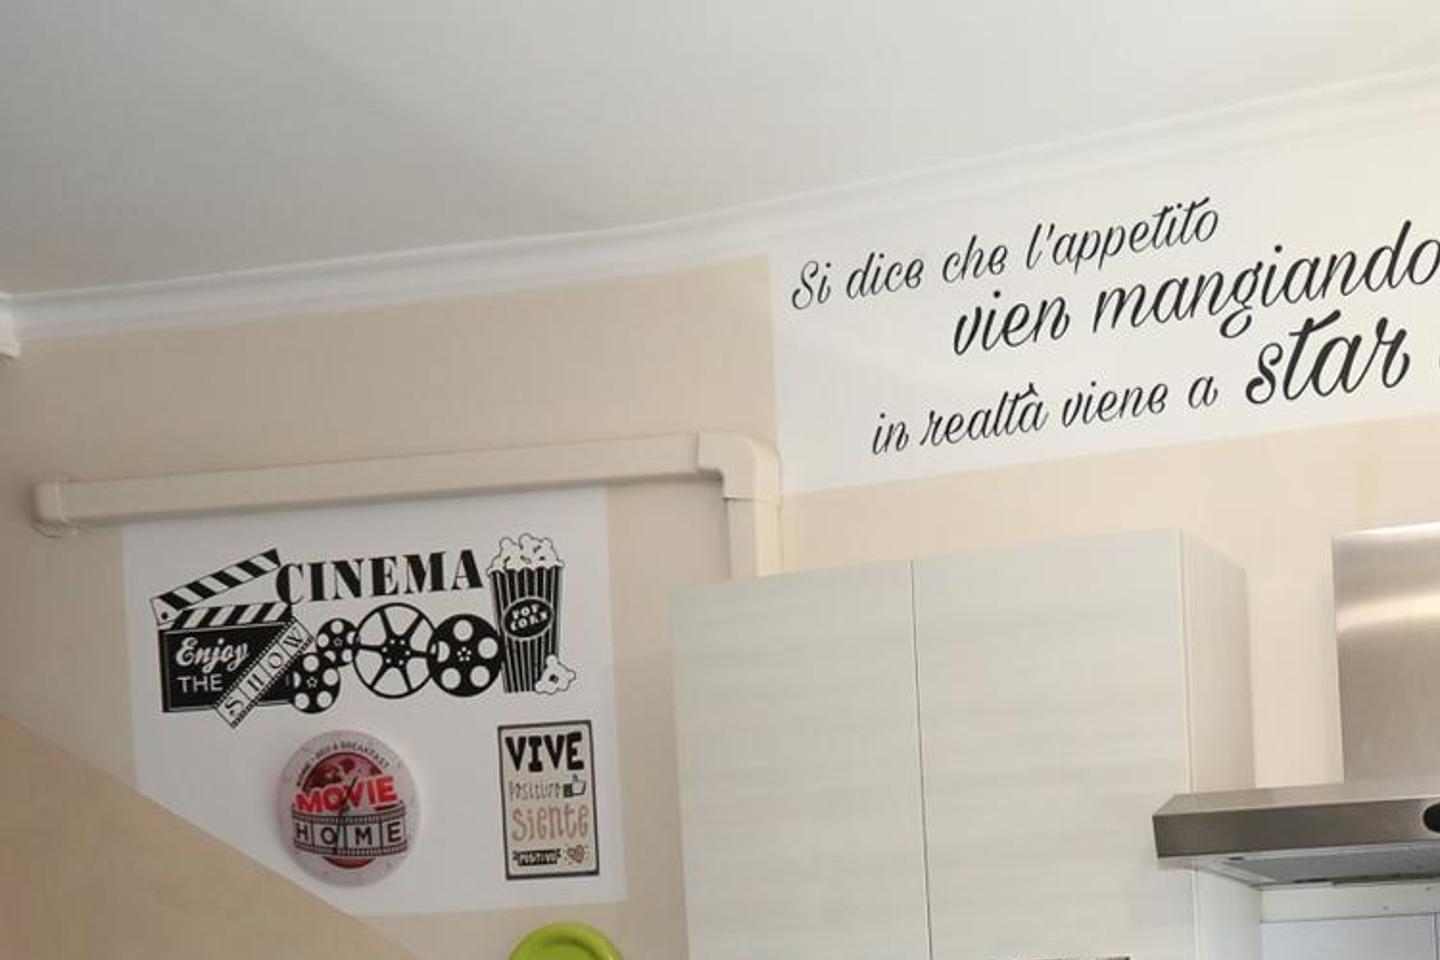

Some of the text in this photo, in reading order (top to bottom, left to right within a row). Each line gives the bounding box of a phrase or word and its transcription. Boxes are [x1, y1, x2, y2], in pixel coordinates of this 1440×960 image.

[791, 196, 1219, 311] Si dice che l'appetito
[953, 289, 1071, 356] vien
[871, 412, 910, 456] in
[919, 381, 1049, 447] realtà
[1061, 380, 1169, 428] viene
[1187, 375, 1219, 409] a
[1245, 309, 1411, 405] star
[275, 548, 484, 605] CINEMA
[511, 603, 541, 620] POP
[175, 636, 249, 674] Enjoy
[224, 624, 304, 716] SHOW
[176, 673, 224, 694] THE
[504, 731, 585, 773] VIVE
[295, 776, 398, 813] MOVIE
[296, 821, 402, 846] HOME
